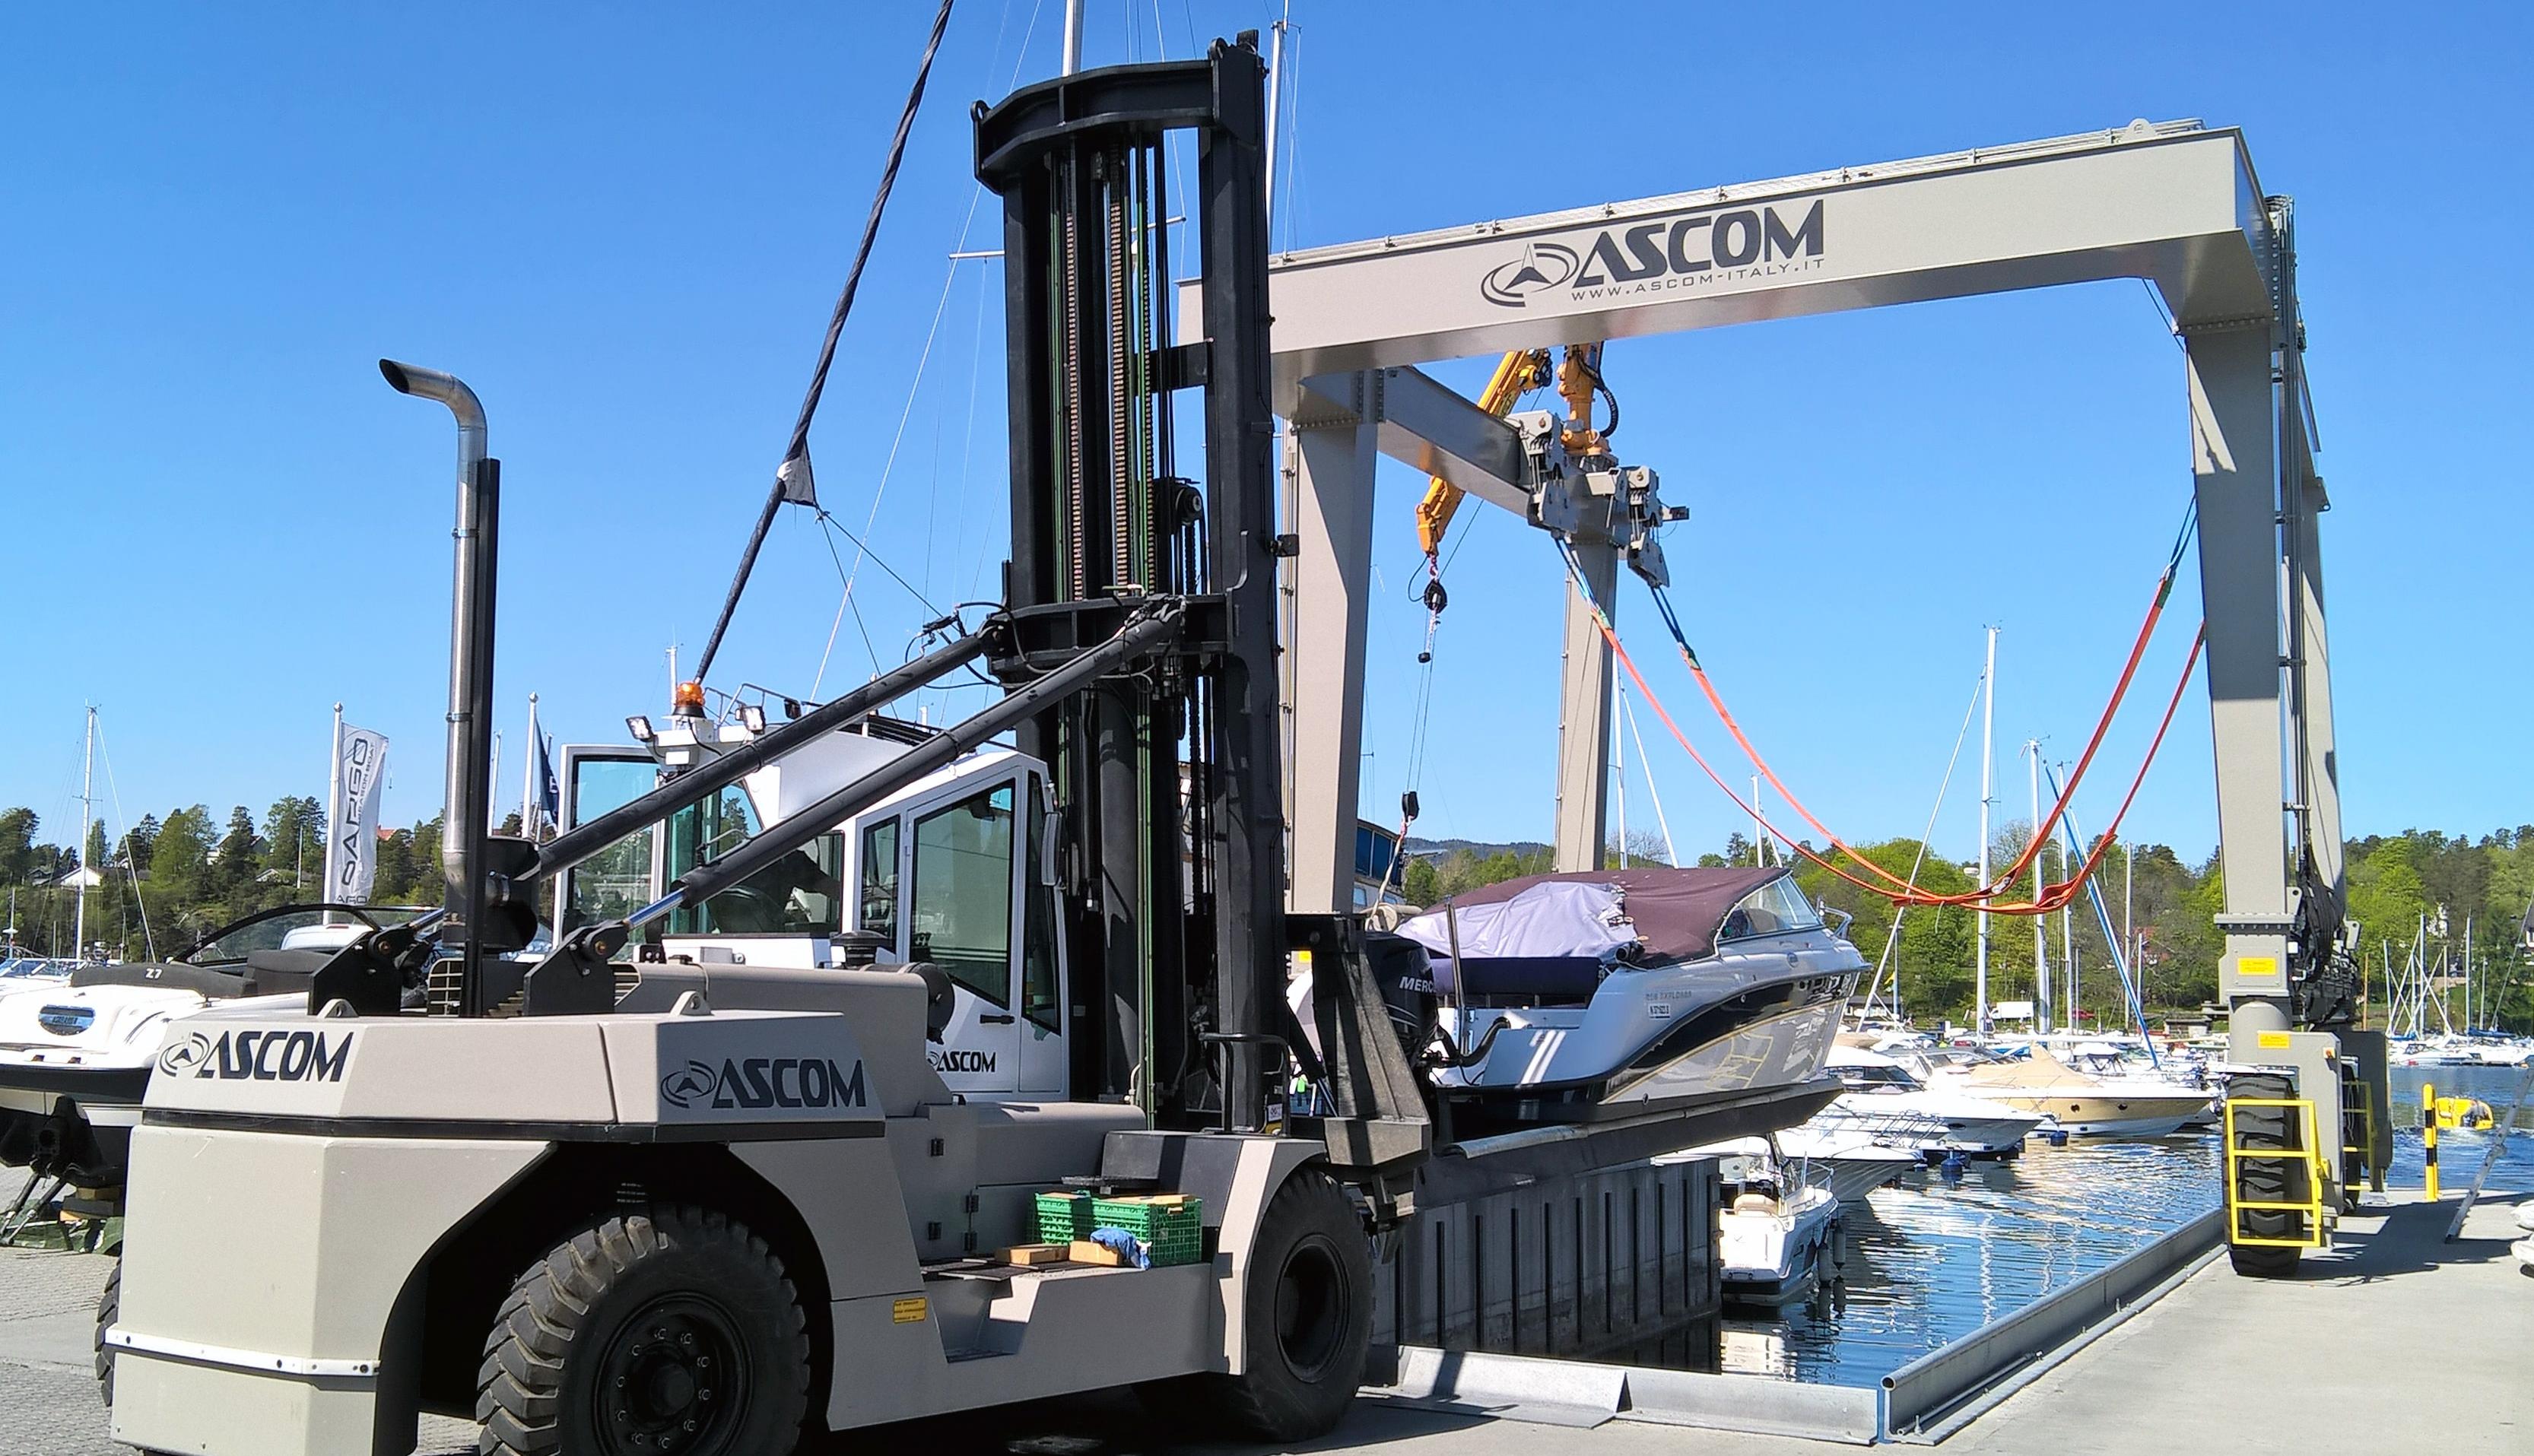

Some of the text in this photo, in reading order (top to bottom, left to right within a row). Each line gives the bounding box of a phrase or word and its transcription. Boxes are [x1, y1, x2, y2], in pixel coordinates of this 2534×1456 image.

[1572, 199, 1824, 287] ASCOM
[1572, 259, 1824, 300] WWW.ASCOM-ITALY.IT
[1399, 976, 1437, 993] MERC
[194, 1030, 354, 1082] ASCOM
[936, 1051, 996, 1072] ASCOM
[711, 1058, 867, 1109] ASCOM
